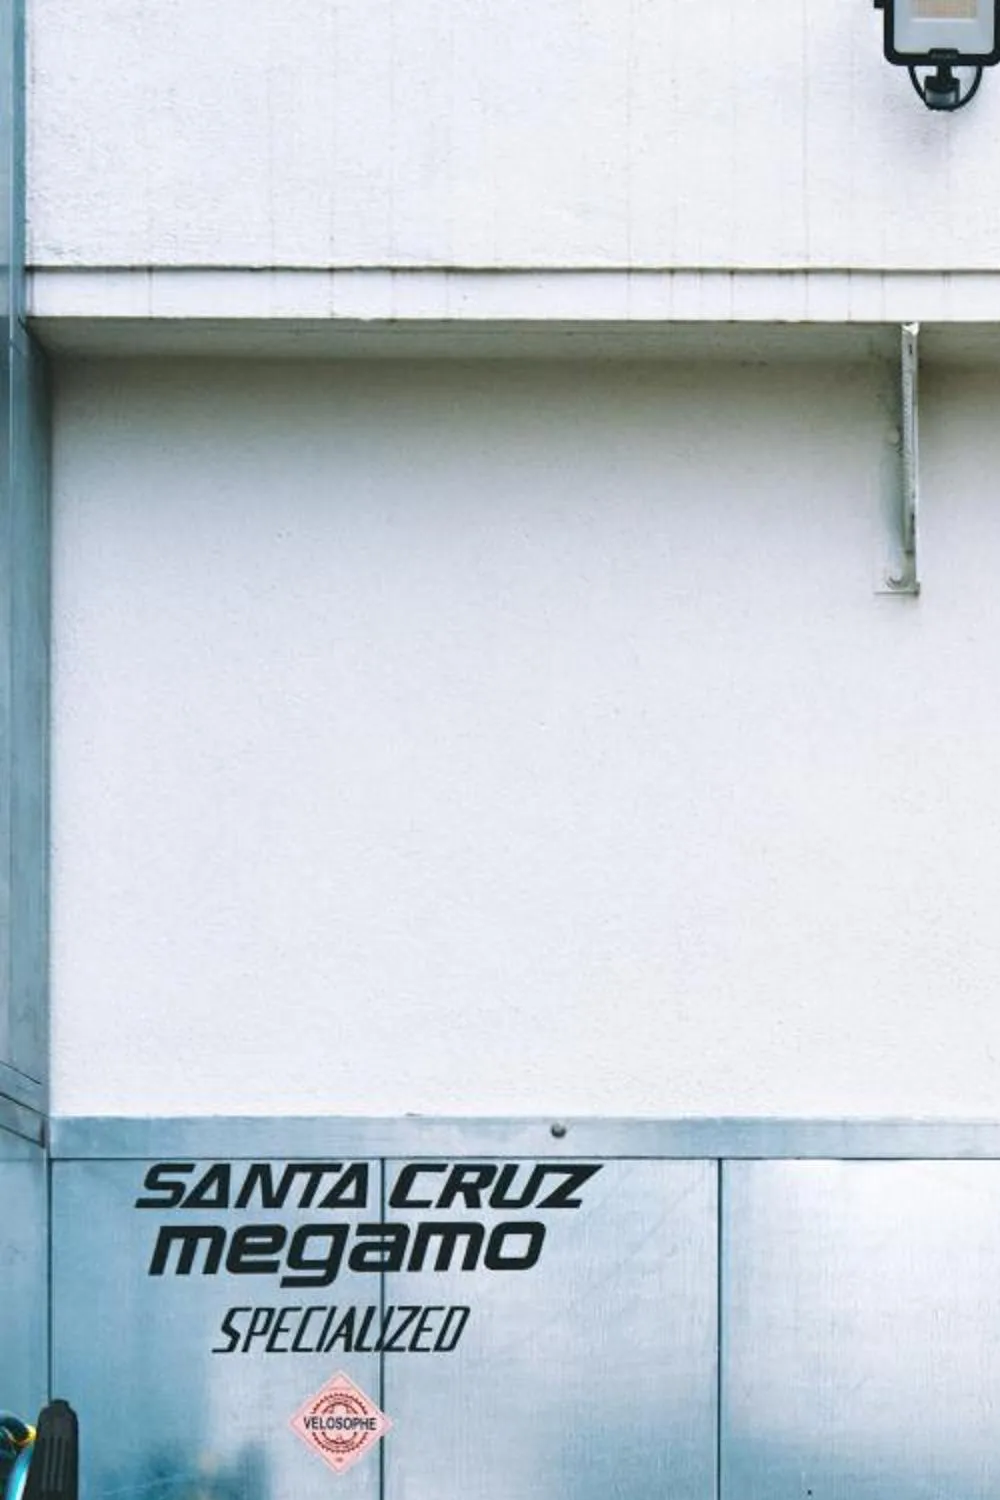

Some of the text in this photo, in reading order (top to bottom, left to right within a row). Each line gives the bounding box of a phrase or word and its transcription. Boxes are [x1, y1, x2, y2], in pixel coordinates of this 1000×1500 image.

[135, 1163, 604, 1209] SANTA CRUZ
[148, 1221, 547, 1288] megamo
[211, 1306, 471, 1353] SPECIALIZED
[303, 1416, 377, 1431] VELOSOPHE
